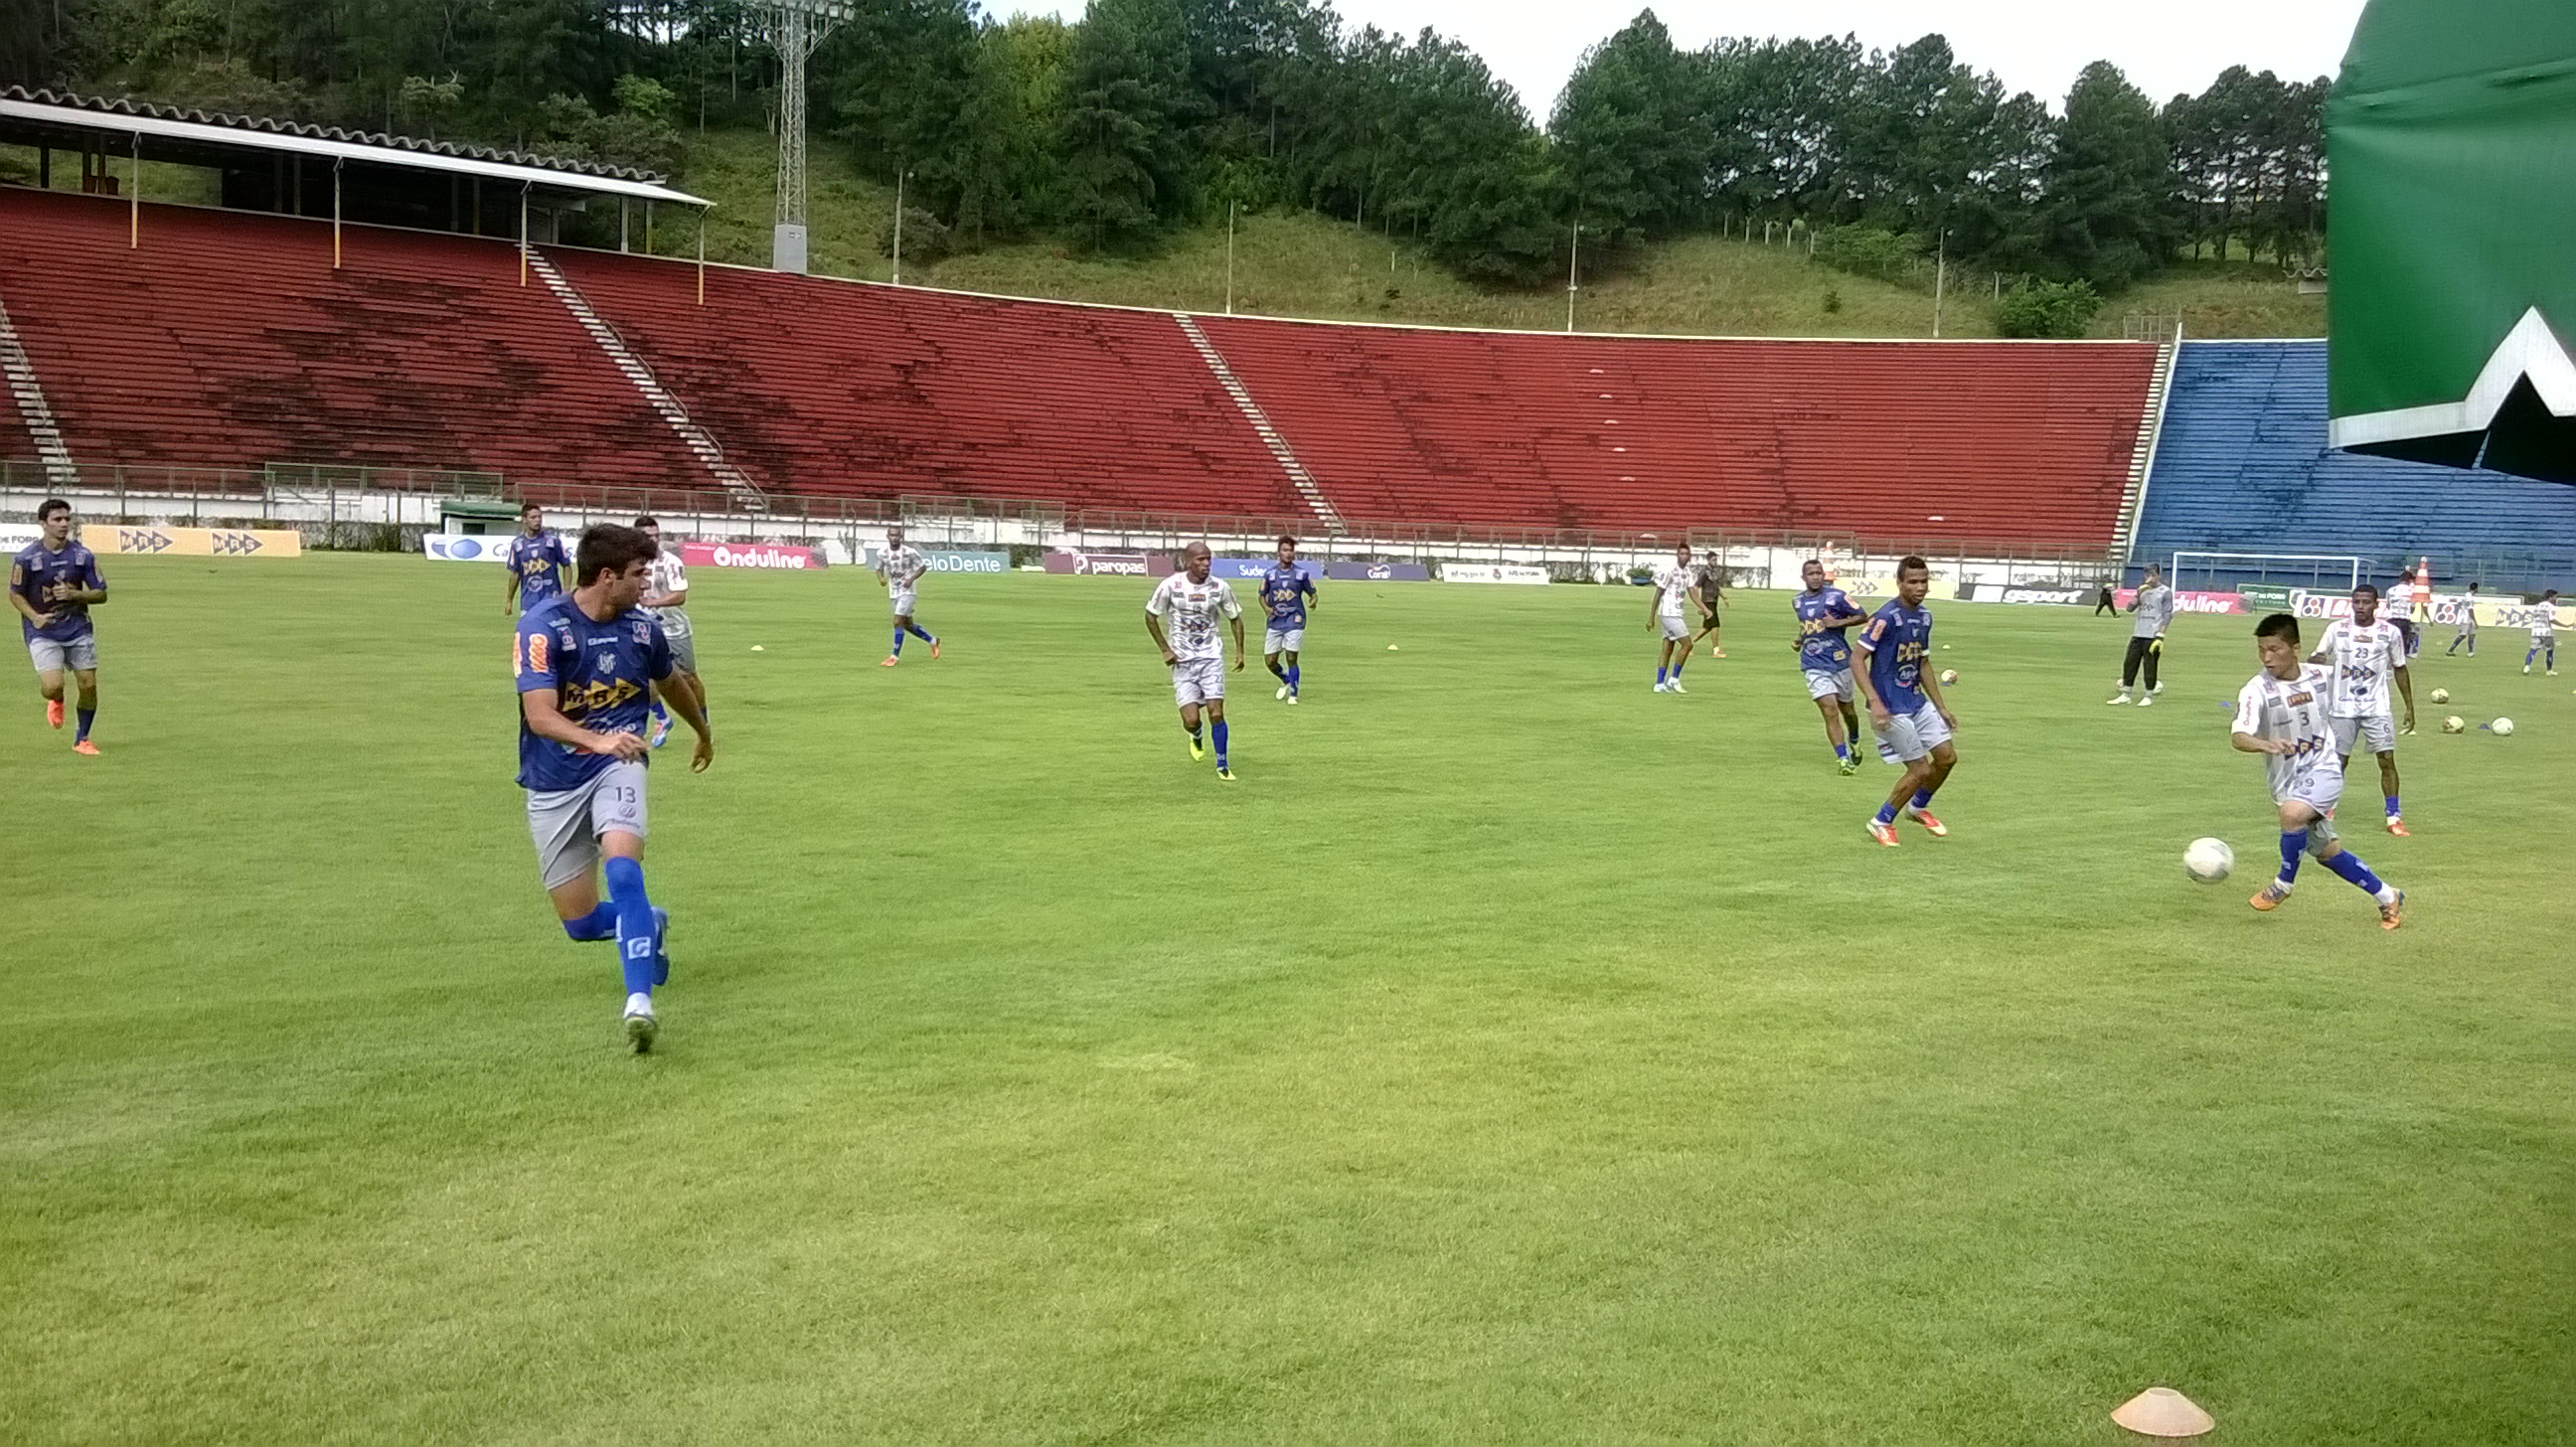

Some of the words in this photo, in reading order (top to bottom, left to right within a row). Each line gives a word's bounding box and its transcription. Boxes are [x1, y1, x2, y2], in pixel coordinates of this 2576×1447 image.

[121, 535, 165, 548] MRS
[214, 538, 255, 550] MRS
[714, 546, 805, 569] Onduline
[922, 555, 1002, 572] eloDente
[1091, 561, 1146, 575] paropas
[2174, 594, 2231, 613] duline
[2496, 612, 2534, 623] MRS
[2354, 647, 2369, 659] 23
[2299, 711, 2311, 726] 3
[615, 786, 637, 803] 13
